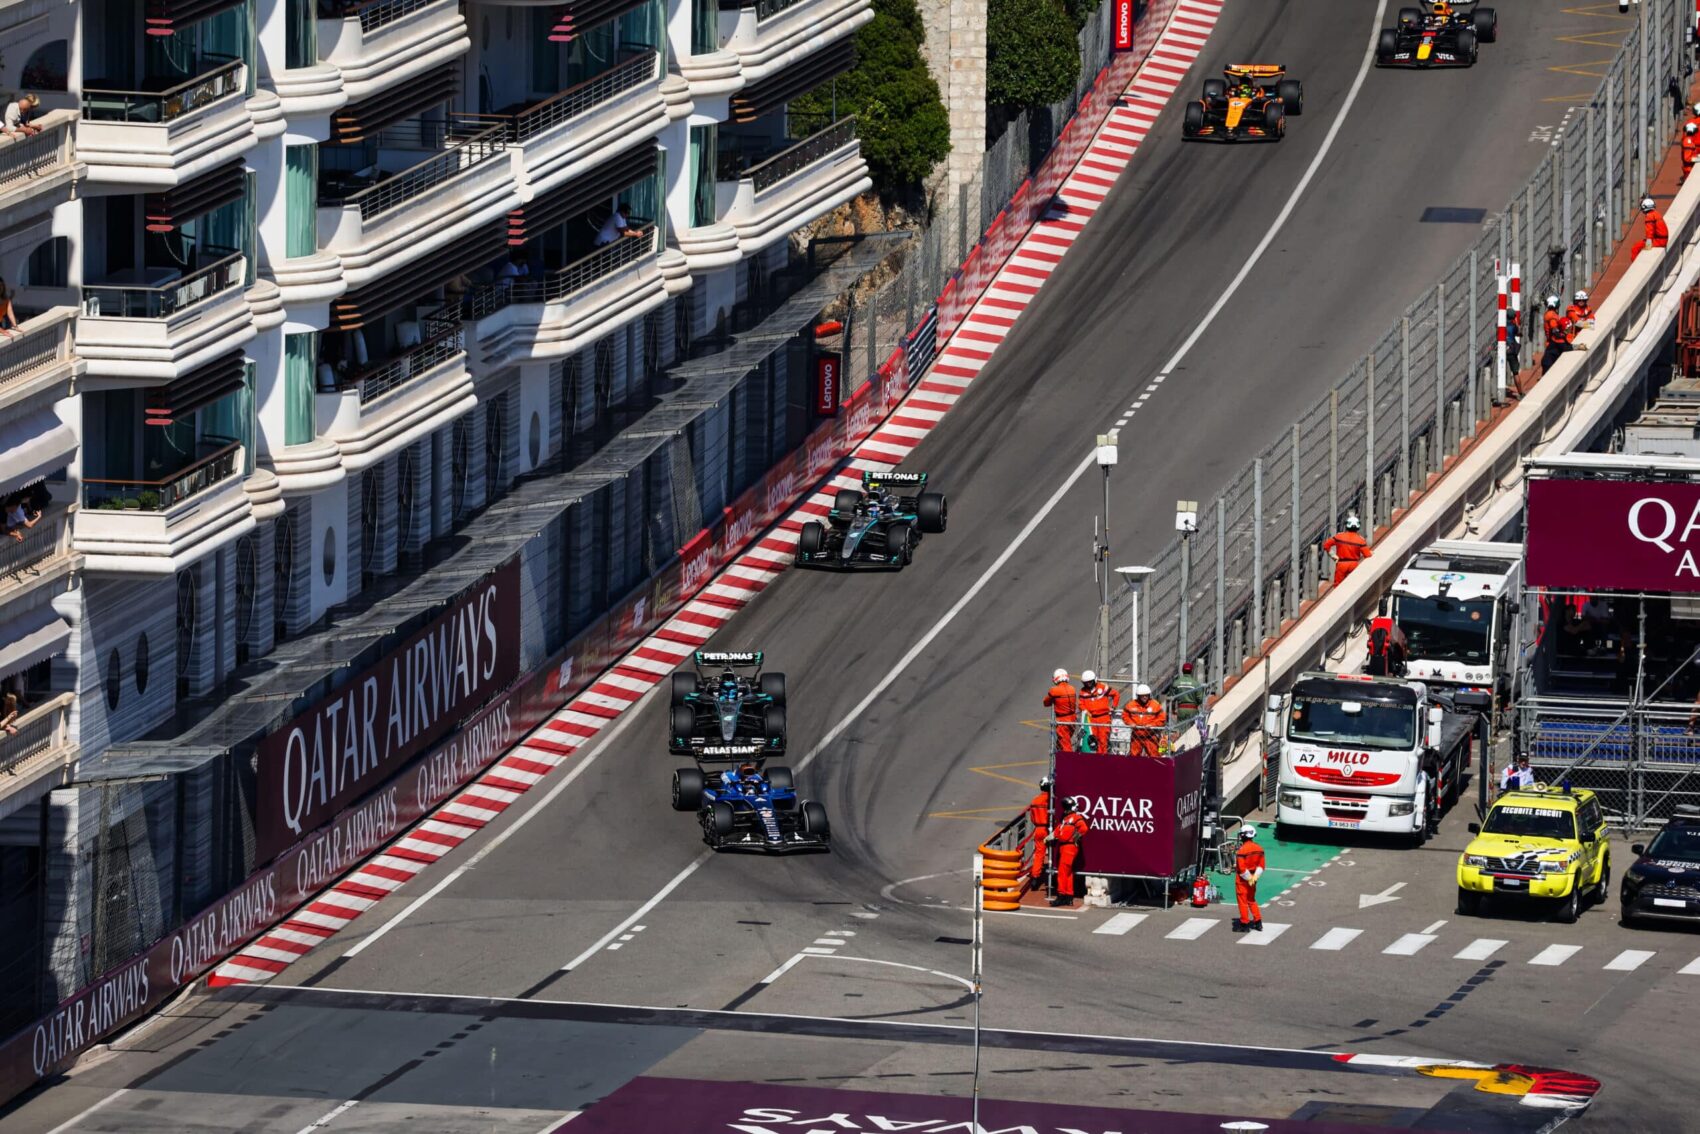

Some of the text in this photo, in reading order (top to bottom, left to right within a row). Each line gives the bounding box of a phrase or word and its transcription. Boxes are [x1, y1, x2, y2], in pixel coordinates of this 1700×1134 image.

[1119, 2, 1128, 44] Lenovo
[822, 364, 832, 409] Lenovo
[703, 652, 753, 660] PETRONAS
[284, 584, 497, 834] QATAR AIRWAYS
[417, 700, 511, 813] QATAR AIRWAYS
[703, 746, 755, 755] ATLASSIAN
[1299, 753, 1315, 764] A7
[1327, 750, 1369, 765] MILLO
[1071, 795, 1153, 819] QATAR
[1177, 790, 1198, 820] QATAR
[1535, 808, 1562, 818] CIRCUIT
[1090, 818, 1154, 833] AIRWAYS
[296, 786, 397, 897] QATAR AIRWAYS
[171, 871, 275, 985] QATAR AIRWAYS
[33, 958, 149, 1077] QATAR AIRWAYS
